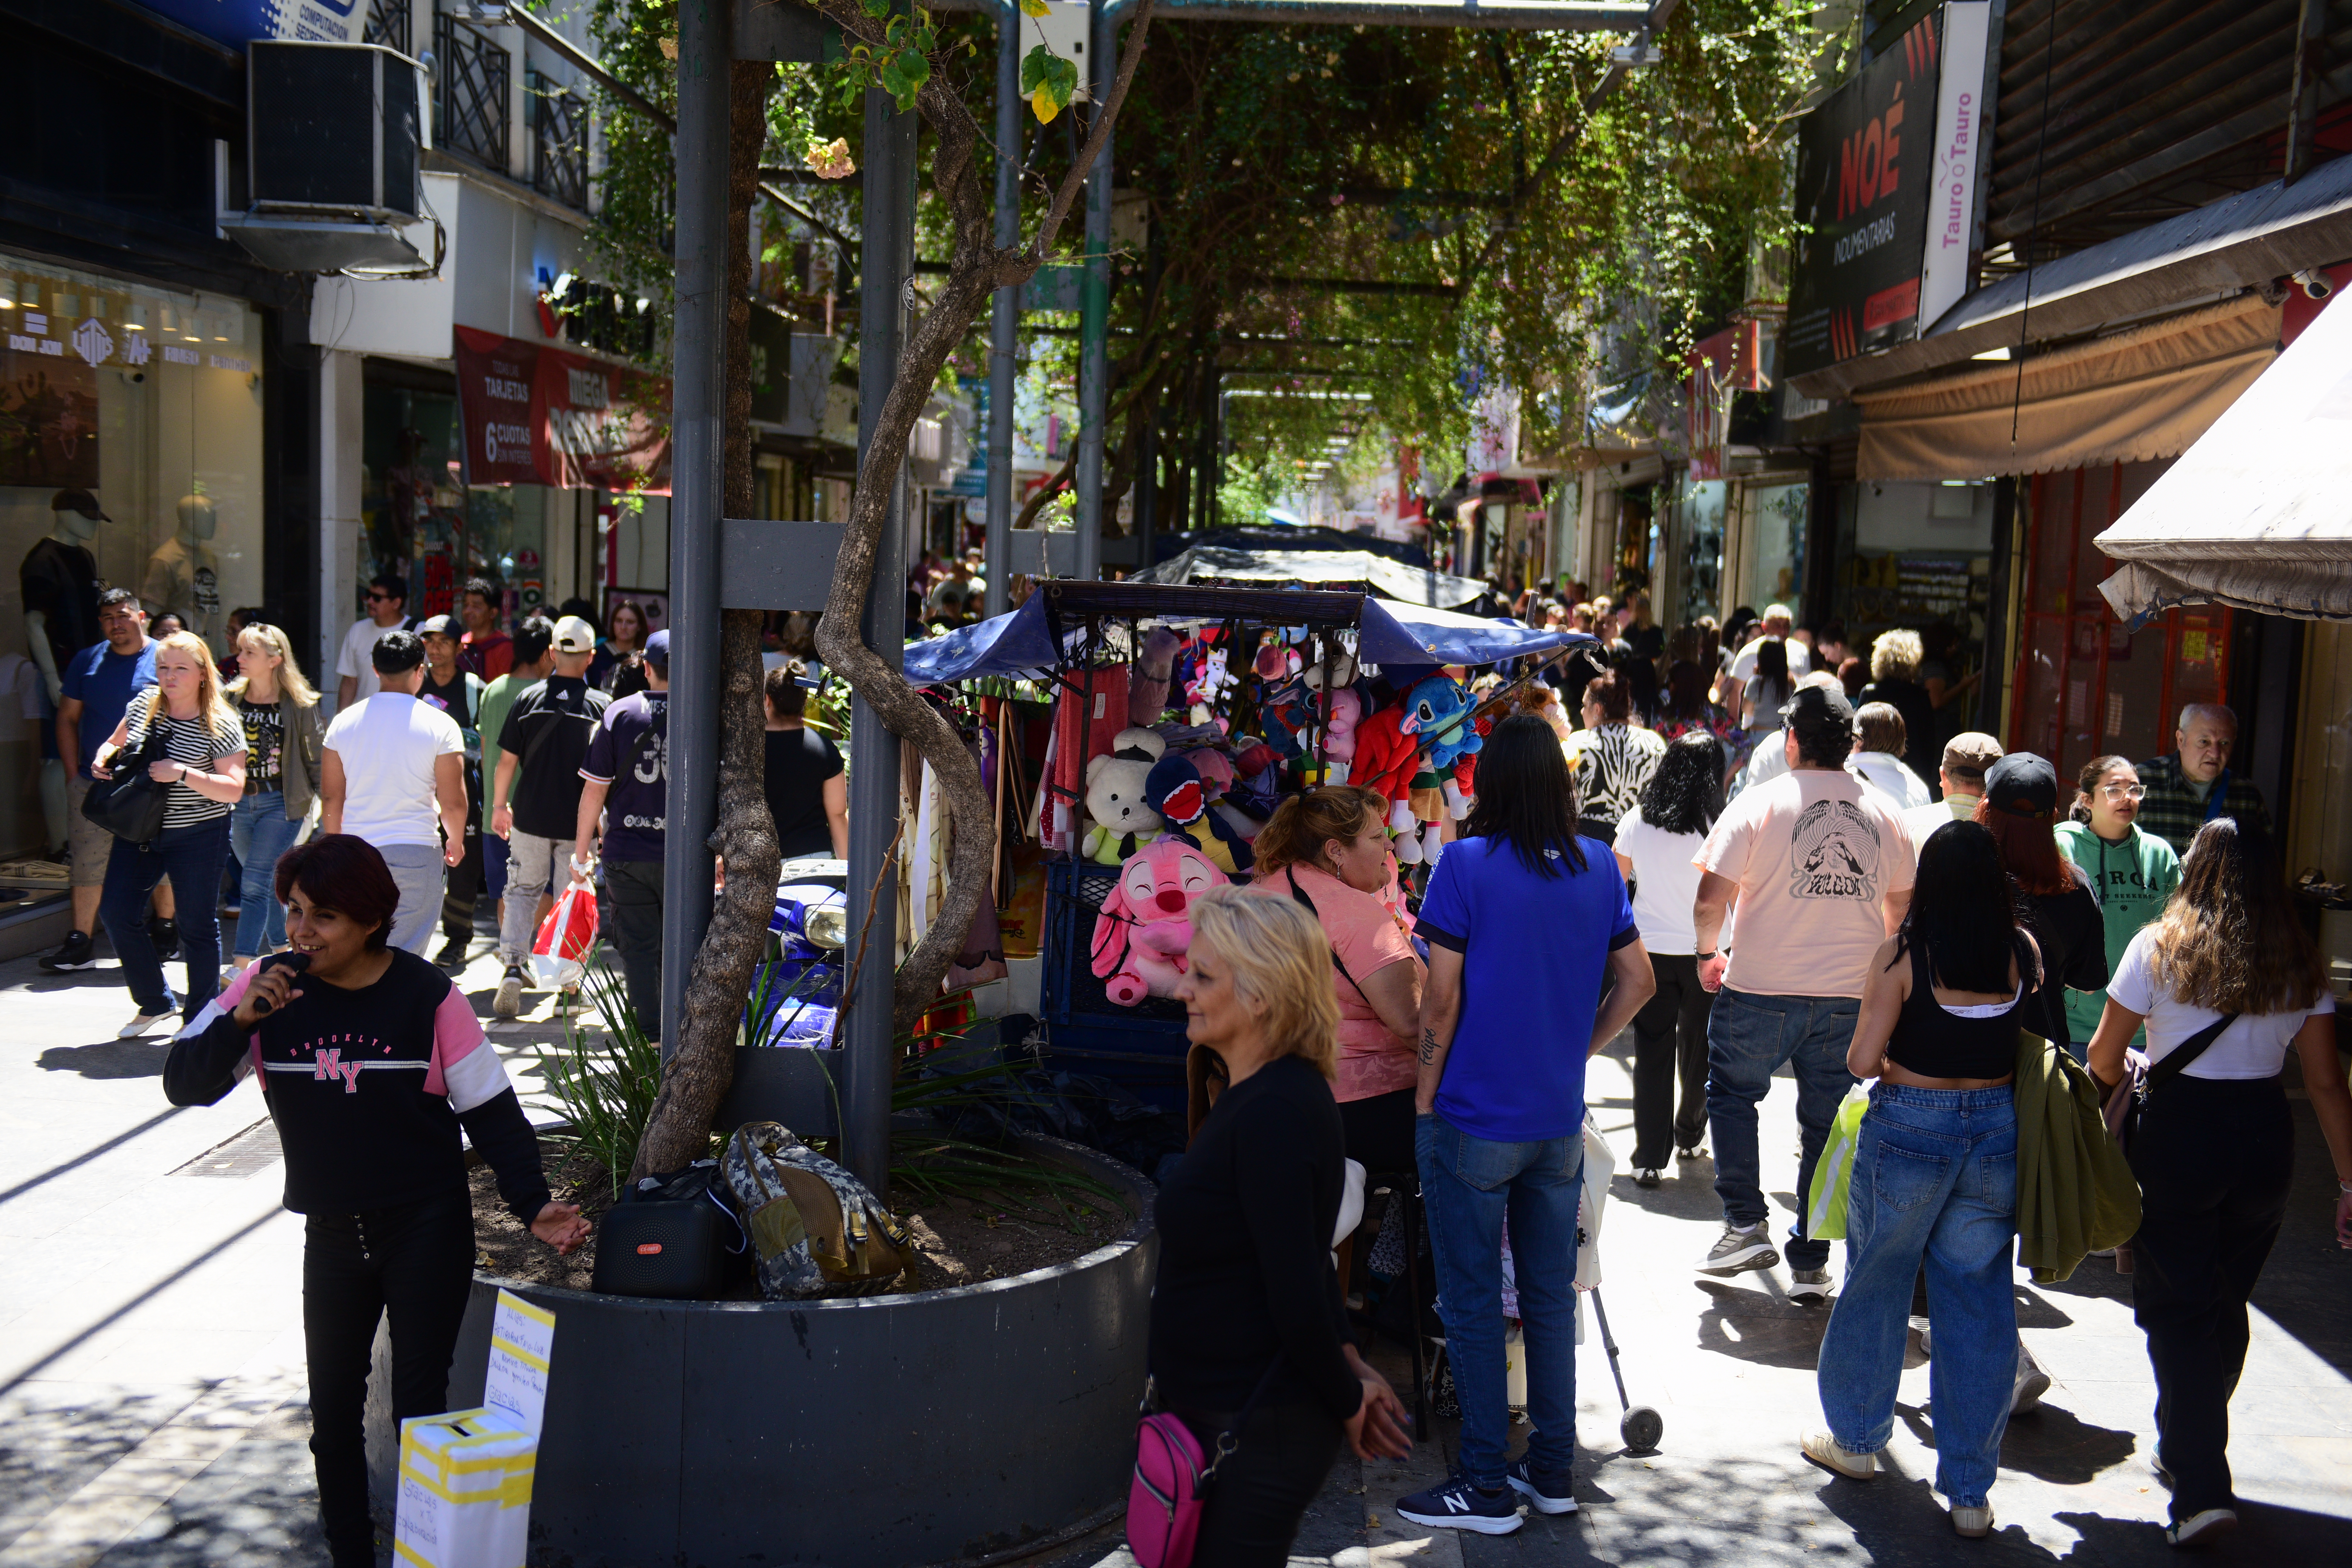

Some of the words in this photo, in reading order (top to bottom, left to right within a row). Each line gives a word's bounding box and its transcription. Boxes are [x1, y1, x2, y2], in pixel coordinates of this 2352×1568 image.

[1838, 80, 1905, 221] NOÉ
[1950, 92, 1972, 167] Tauro
[1942, 182, 1964, 249] Tauro
[1833, 210, 1896, 267] INDUMENTARIAS
[9, 334, 36, 352] DON
[38, 339, 63, 357] JON
[484, 376, 529, 404] TARJETAS
[568, 367, 611, 409] MEGA
[485, 421, 498, 463] 6
[496, 423, 531, 446] CUOTAS
[290, 1033, 392, 1057] BROOKLYN
[314, 1048, 364, 1093] NY
[487, 1384, 521, 1413] Gracias
[404, 1477, 437, 1510] Gracias
[1442, 1492, 1470, 1513] N
